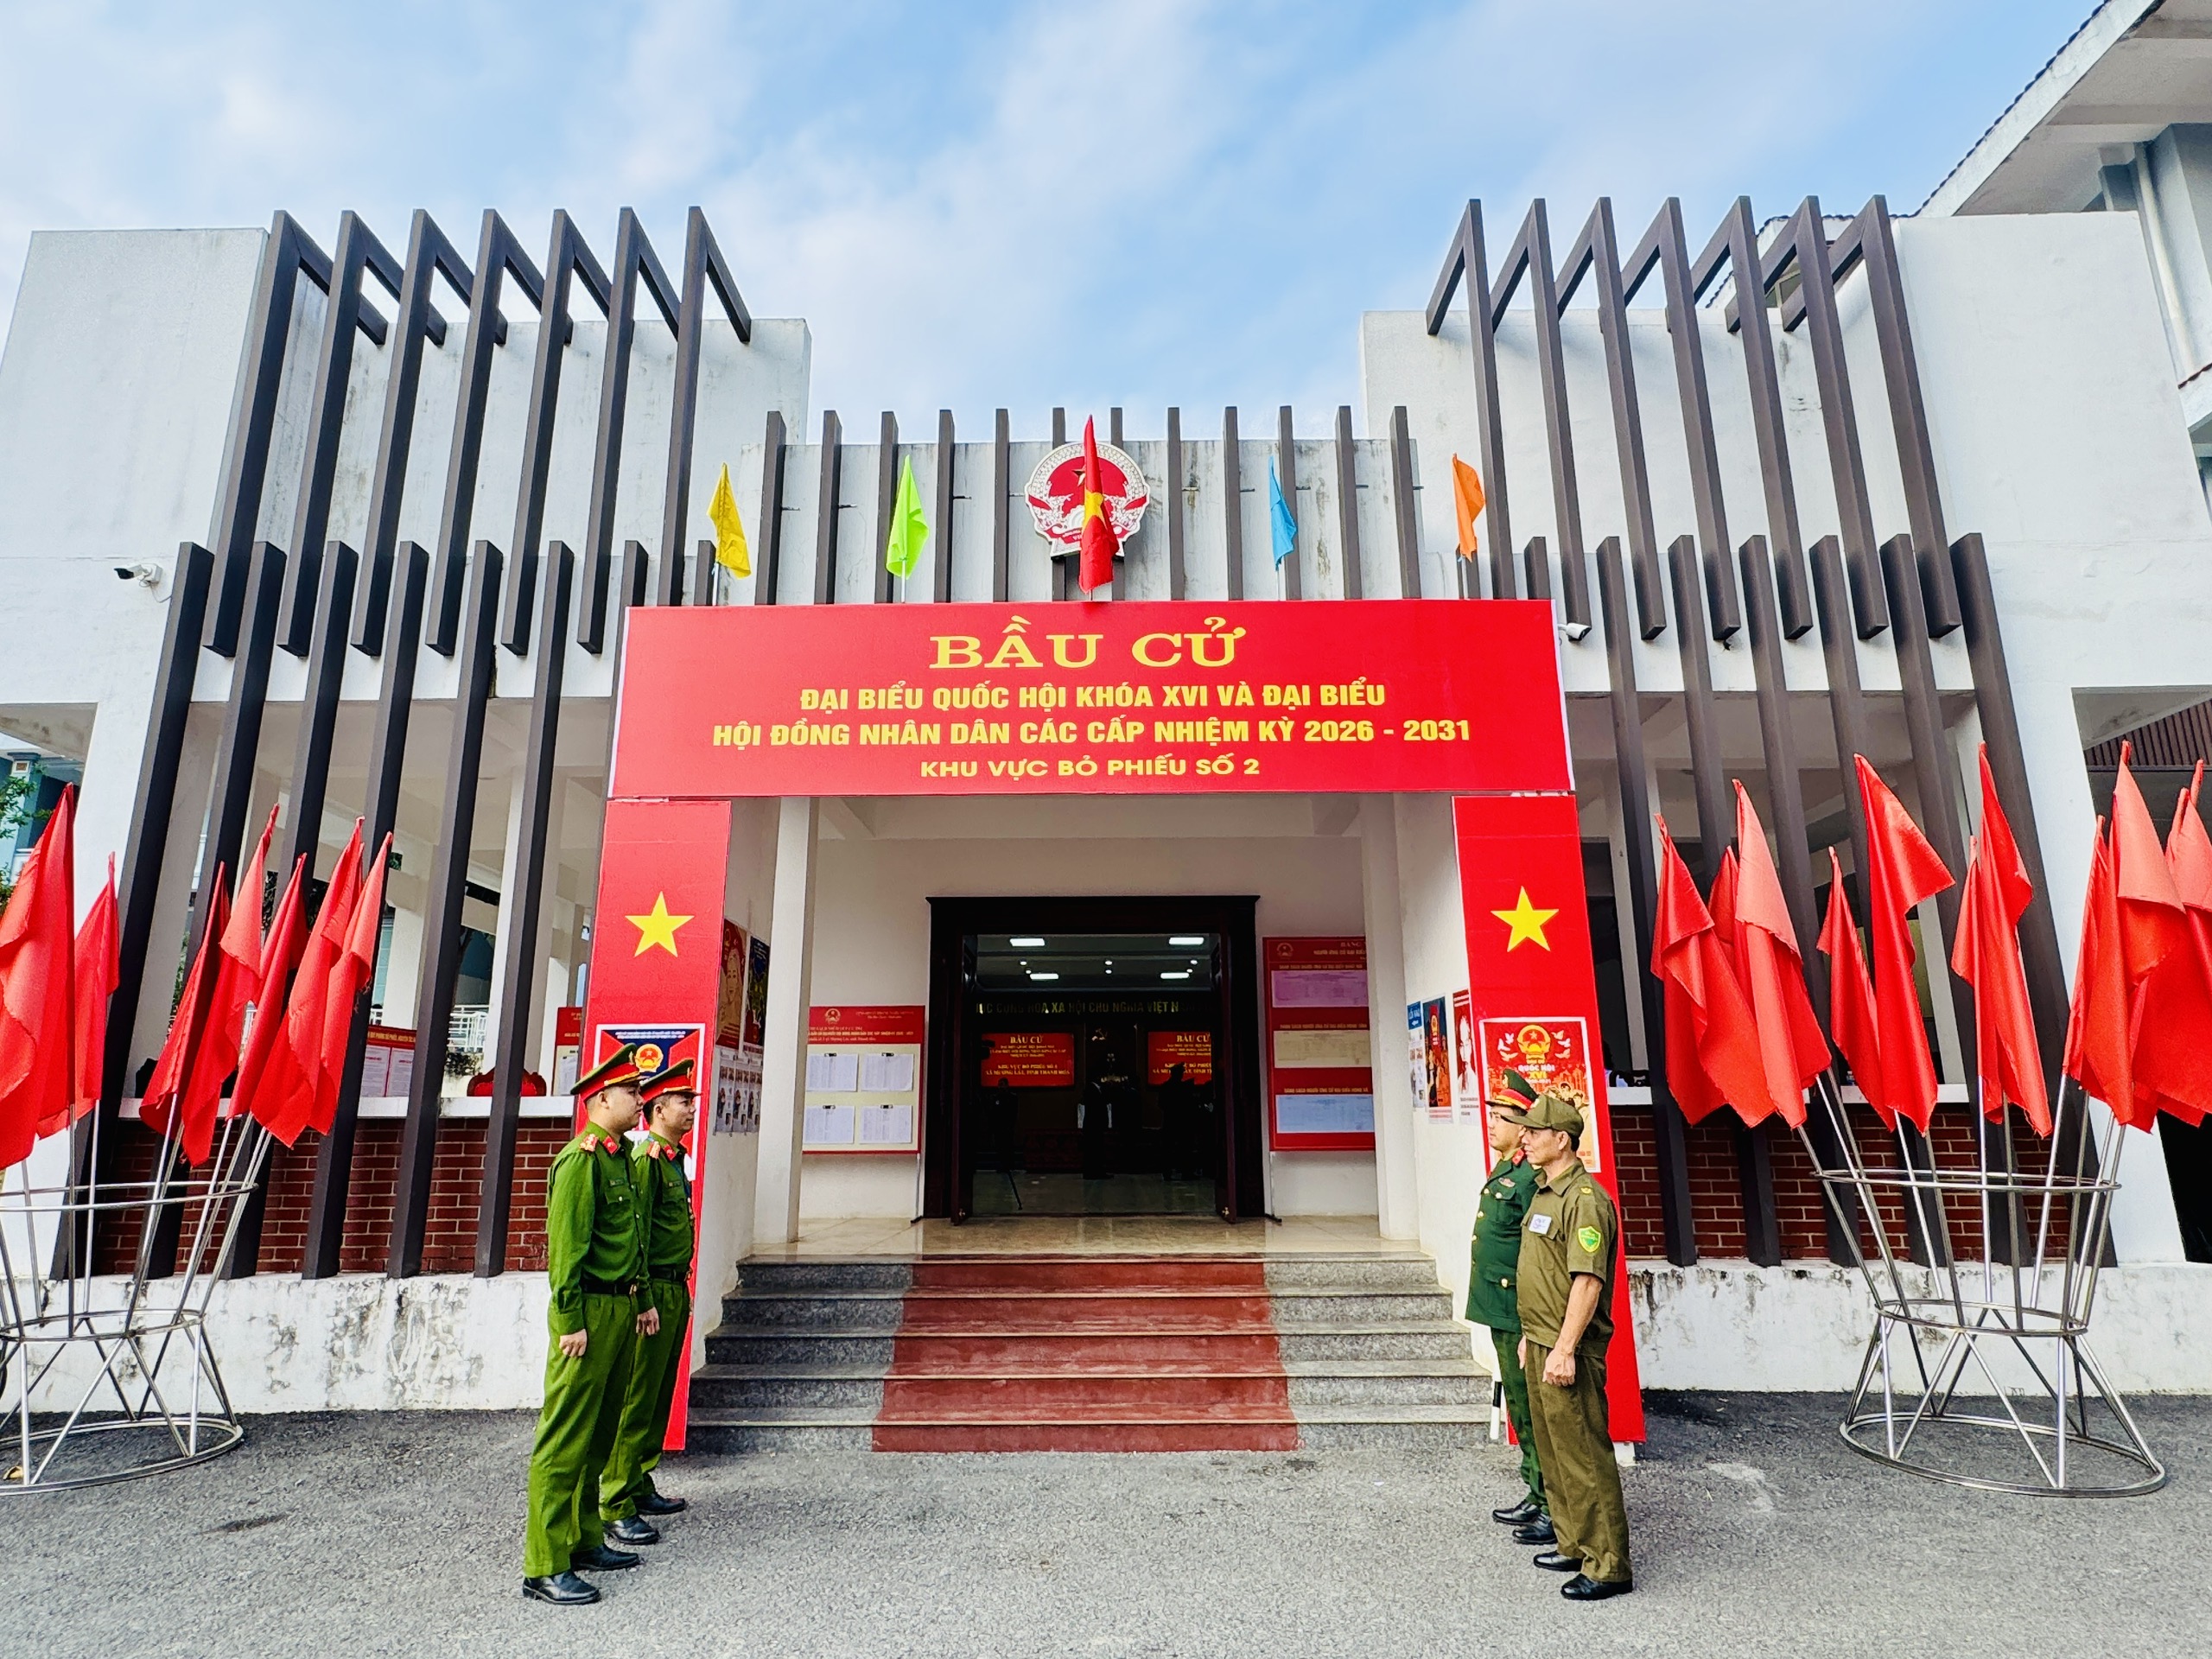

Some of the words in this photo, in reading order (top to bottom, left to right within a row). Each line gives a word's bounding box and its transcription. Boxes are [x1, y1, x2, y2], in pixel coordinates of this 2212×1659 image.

[930, 615, 1103, 670] BẦU
[1131, 616, 1246, 668] CỬ
[799, 687, 849, 714] ĐẠI
[858, 680, 924, 709] BIỂU
[933, 680, 1009, 711] QUỐC
[1019, 682, 1066, 713] HỘI
[1077, 683, 1153, 708] KHÓA
[1163, 685, 1208, 707] XVI
[1217, 681, 1254, 707] VÀ
[1262, 685, 1310, 711] ĐẠI
[1320, 677, 1386, 706] BIỂU
[712, 721, 761, 751] HỘI
[769, 717, 850, 747] ĐỒNG
[859, 718, 942, 746] NHÂN
[950, 718, 1009, 745] DÂN
[1020, 718, 1077, 744] CÁC
[1087, 714, 1145, 743] CẤP
[1154, 716, 1249, 747] NHIỆM
[1259, 715, 1295, 742] KỲ
[1304, 720, 1375, 742] 2026
[1403, 719, 1471, 741] 2031
[920, 760, 979, 778] KHU
[988, 759, 1048, 781] VỰC
[1058, 754, 1098, 777] BỎ
[1108, 753, 1187, 776] PHIẾU
[1196, 752, 1235, 776] SỐ
[1243, 758, 1260, 775] 2
